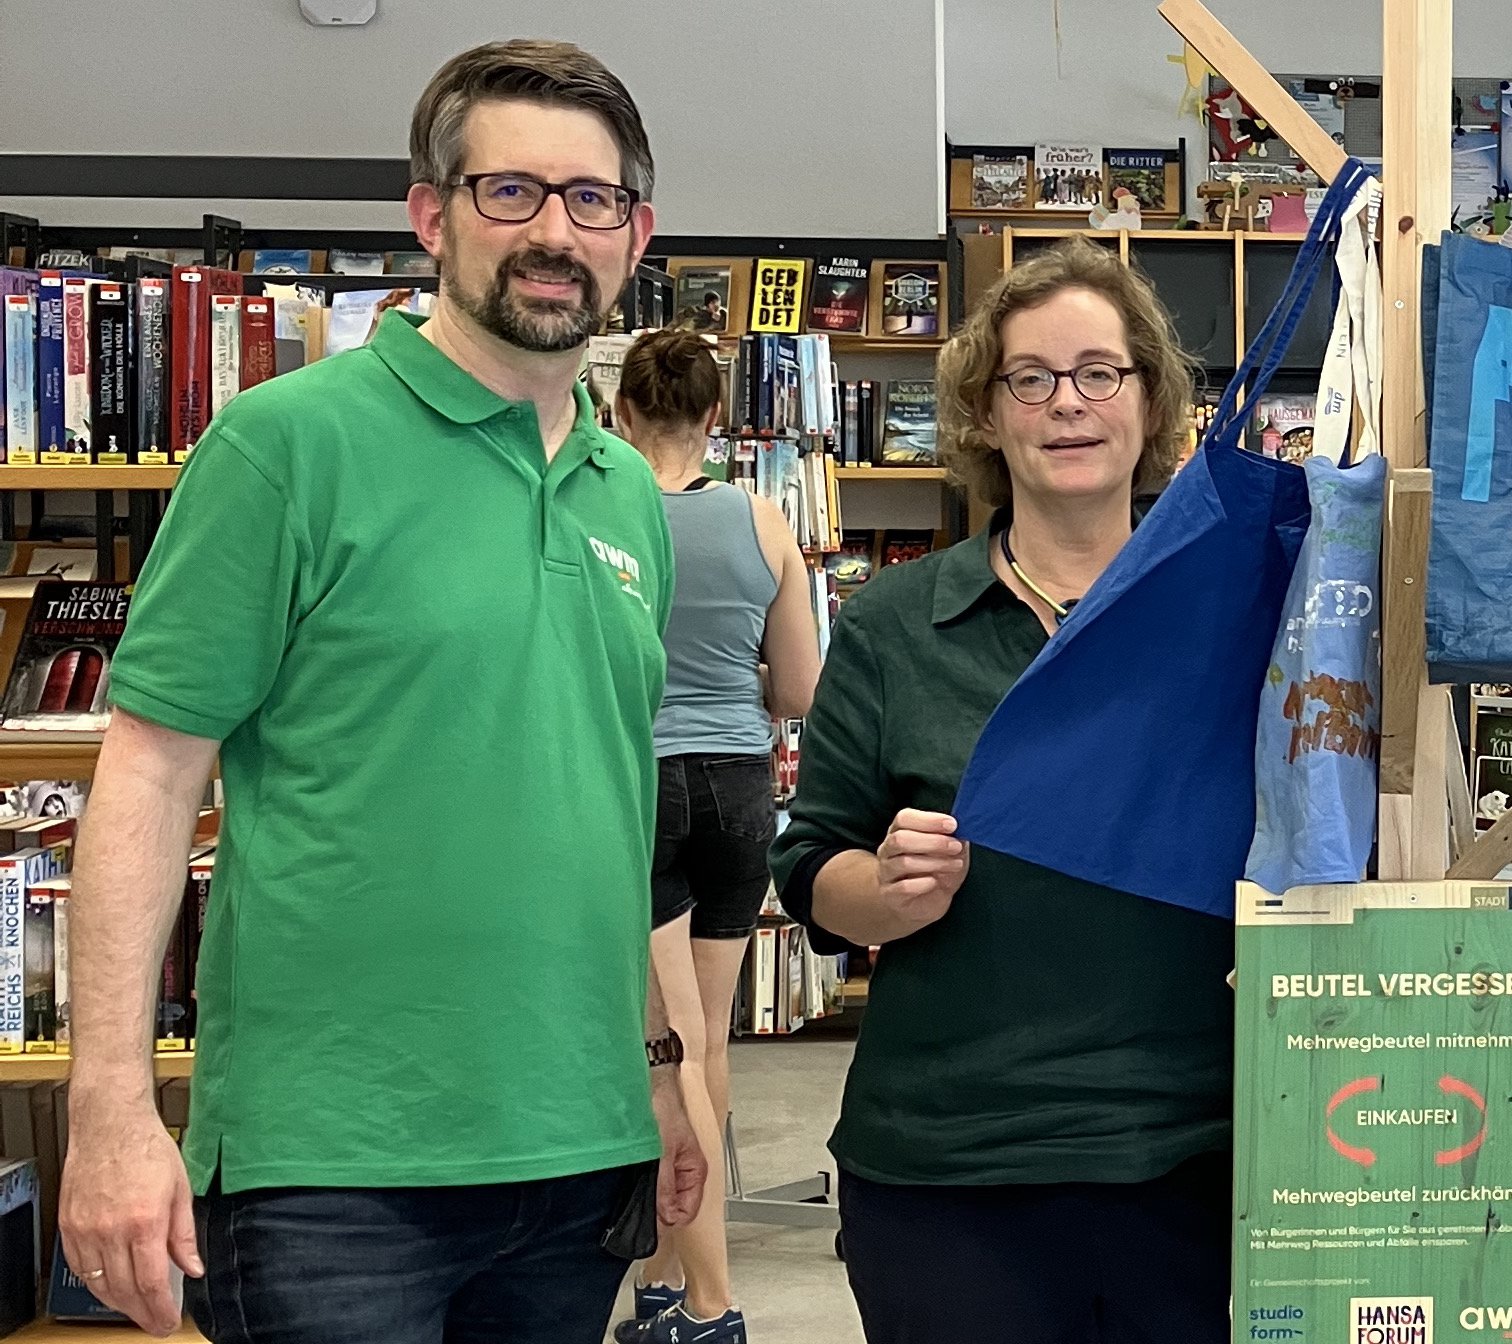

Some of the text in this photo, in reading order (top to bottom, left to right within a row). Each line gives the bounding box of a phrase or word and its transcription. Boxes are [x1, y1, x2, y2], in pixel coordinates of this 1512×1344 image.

[1046, 150, 1094, 164] früher?
[1110, 156, 1164, 167] DIE RITTER
[39, 253, 90, 268] FITZEK
[832, 257, 859, 267] KARIN
[761, 268, 799, 286] GEB
[818, 265, 867, 278] SLAUGHTER
[761, 289, 796, 306] LEN
[52, 298, 63, 340] PROVENCE
[759, 308, 794, 327] DET
[1332, 392, 1346, 413] dm
[69, 587, 125, 602] SABINE
[47, 601, 127, 620] THIESLE
[24, 851, 65, 886] KATH
[1474, 897, 1506, 907] STADT
[6, 878, 22, 1031] REICHS KNOCHEN
[1271, 974, 1371, 998] BEUTEL
[1287, 1033, 1431, 1052] Mehrwegbeutel
[1357, 1108, 1457, 1126] EINKAUFEN
[1273, 1187, 1417, 1207] Mehrwegbeutel
[1251, 1229, 1268, 1237] Von
[1328, 1227, 1347, 1236] und
[1349, 1226, 1385, 1237] Bürgern
[1387, 1225, 1400, 1235] für
[1402, 1225, 1416, 1234] Sie
[1250, 1241, 1266, 1250] Mit
[1312, 1240, 1365, 1249] Ressourcen
[1366, 1238, 1385, 1247] und
[1250, 1305, 1303, 1320] studio
[1358, 1306, 1426, 1325] HANSA
[1250, 1325, 1303, 1340] form-
